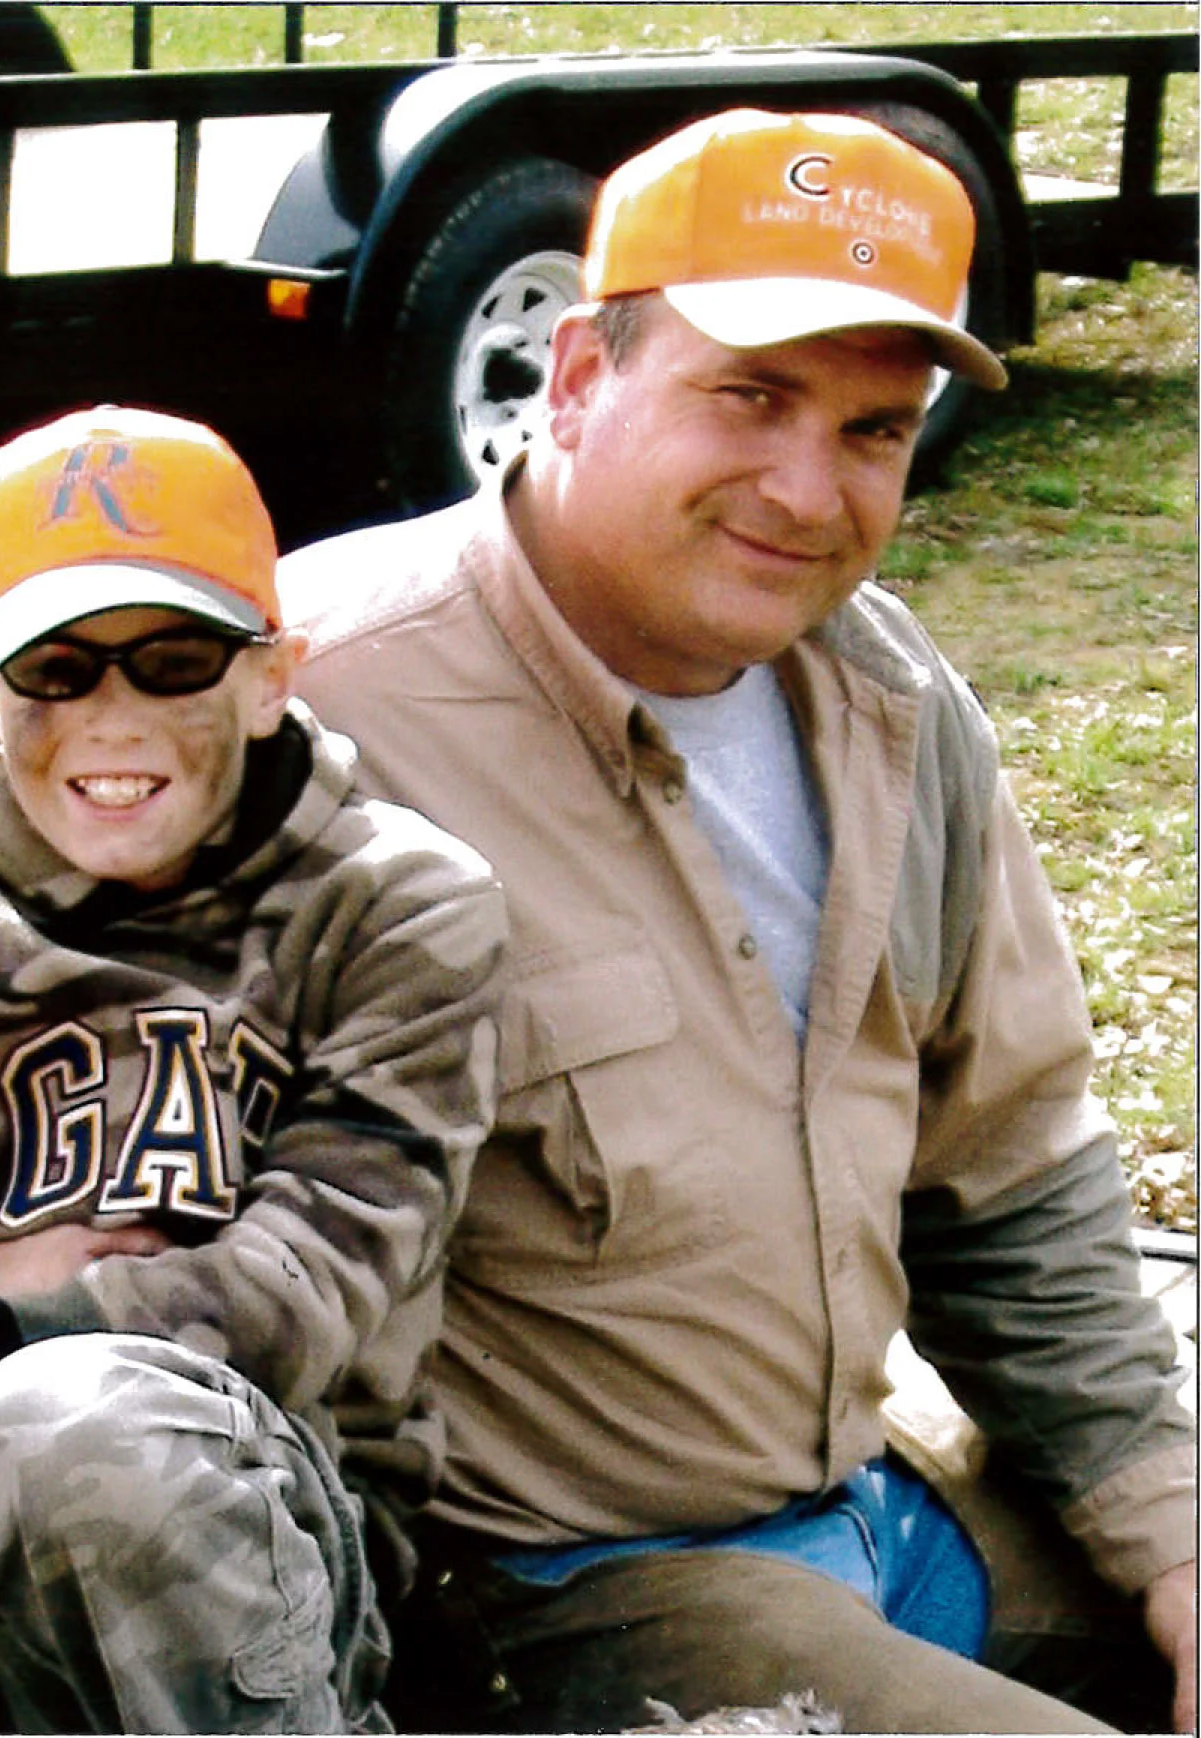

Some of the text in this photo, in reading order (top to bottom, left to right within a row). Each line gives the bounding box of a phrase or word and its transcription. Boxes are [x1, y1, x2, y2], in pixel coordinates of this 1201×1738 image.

[742, 201, 944, 267] LAND DEVELO
[783, 152, 934, 235] CYCLONE
[36, 441, 162, 536] R
